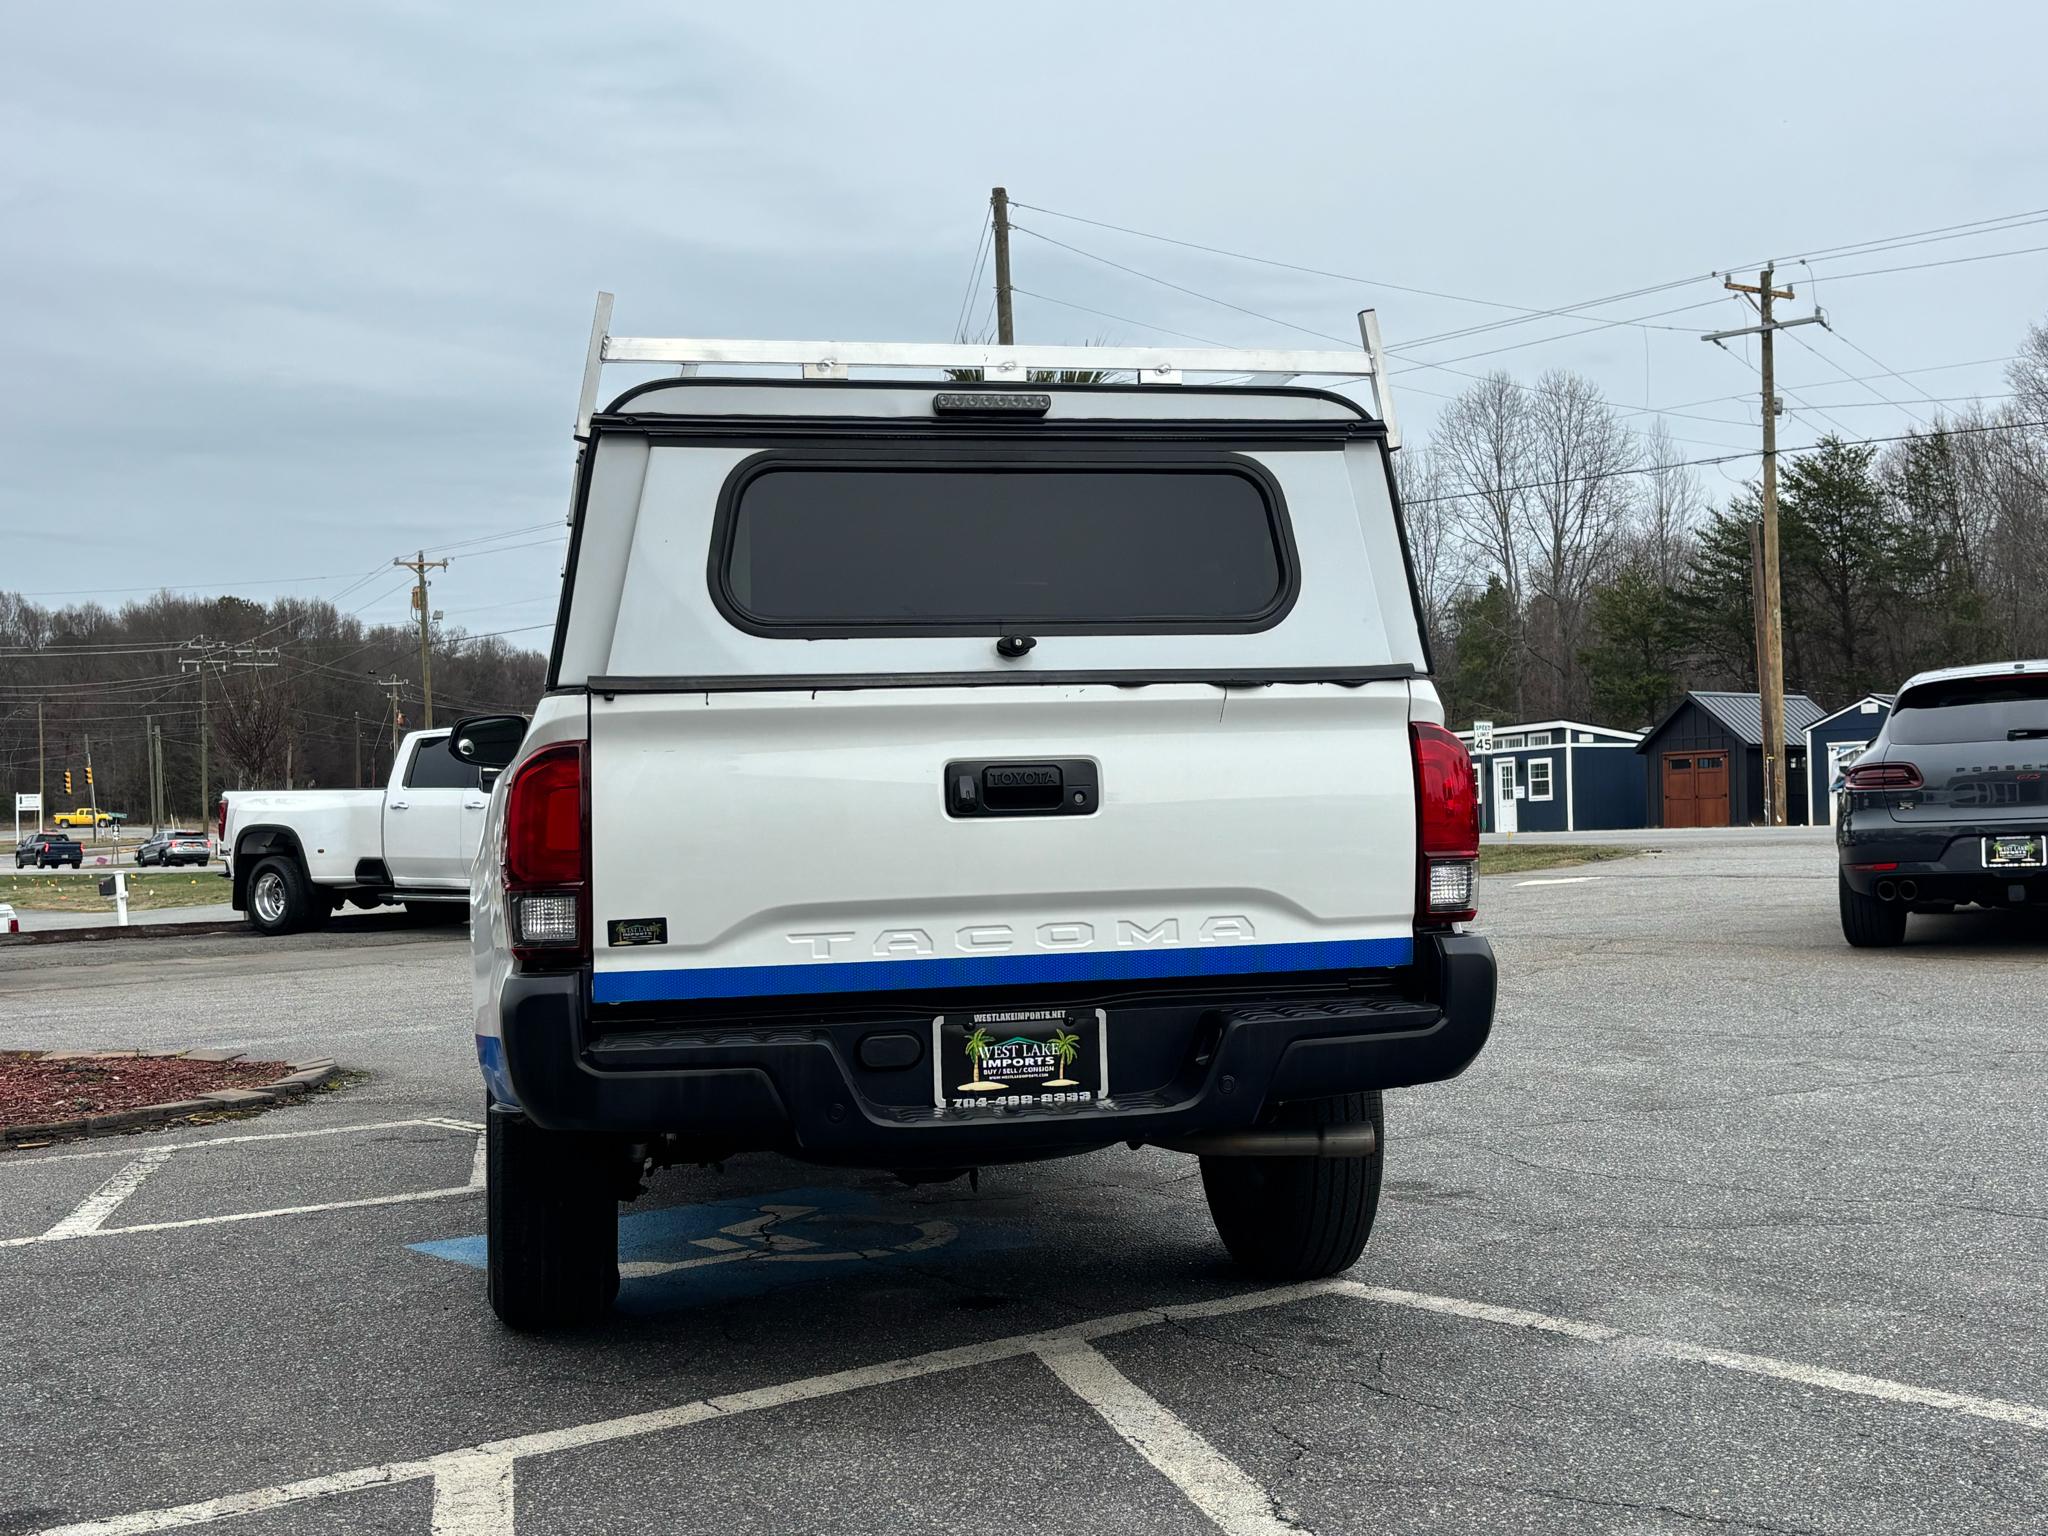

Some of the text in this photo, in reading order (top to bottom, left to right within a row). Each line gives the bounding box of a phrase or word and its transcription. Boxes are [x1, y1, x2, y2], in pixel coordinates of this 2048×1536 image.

[1475, 738, 1491, 750] 45
[989, 771, 1057, 785] TOYOTA
[785, 914, 1257, 959] TACOMA
[973, 1010, 1066, 1023] WESTLAKEIMPORTS.NET
[979, 1043, 1060, 1059] WEST LAKE
[983, 1056, 1055, 1069] IMPORTS
